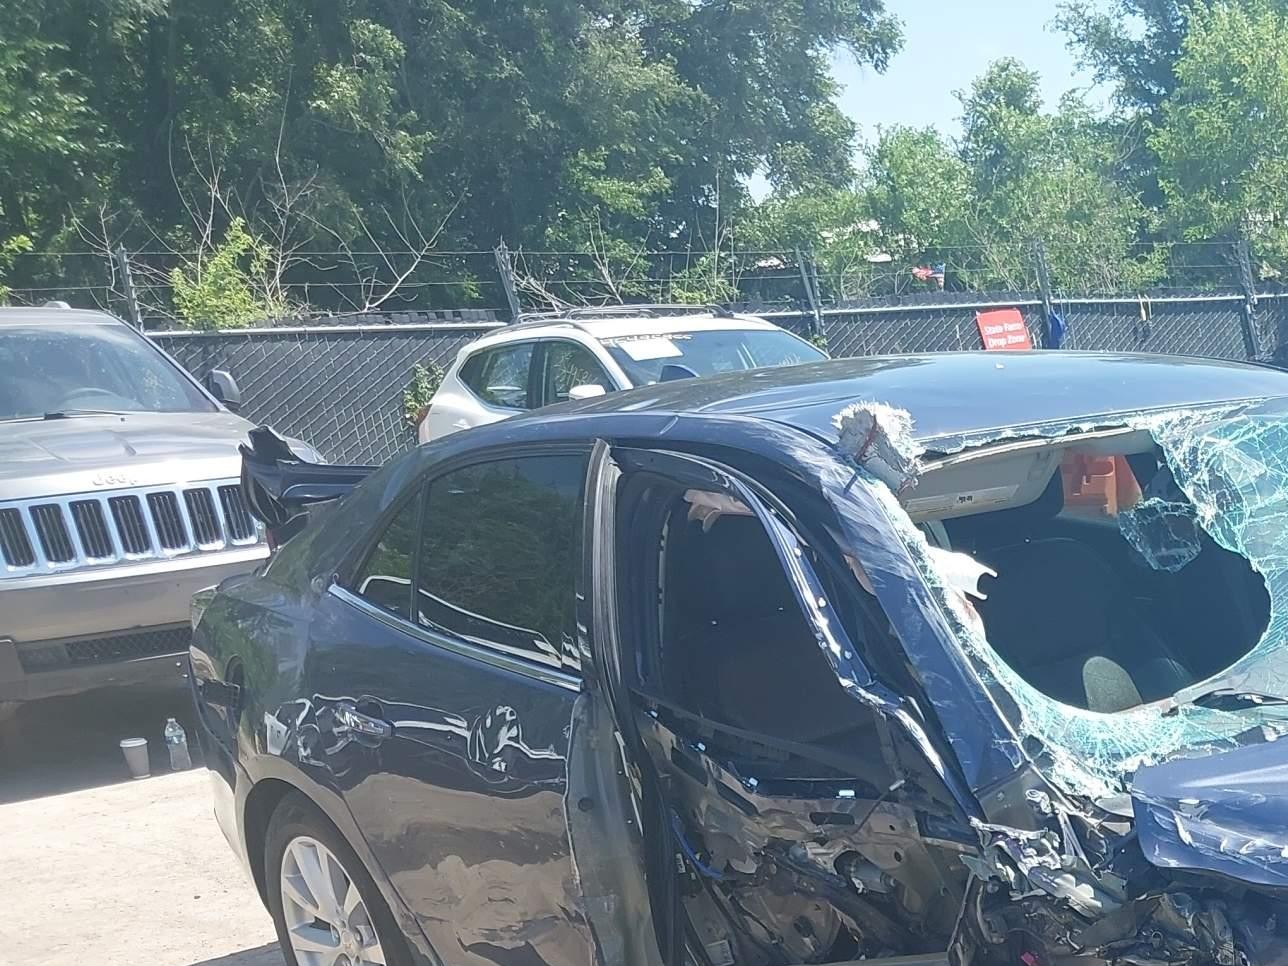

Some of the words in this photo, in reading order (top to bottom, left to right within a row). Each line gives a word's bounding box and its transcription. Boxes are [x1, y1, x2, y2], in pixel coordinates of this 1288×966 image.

[984, 325, 1004, 336] State
[1003, 322, 1023, 332] Farm
[988, 337, 1008, 349] Drop
[1007, 334, 1025, 345] Zone
